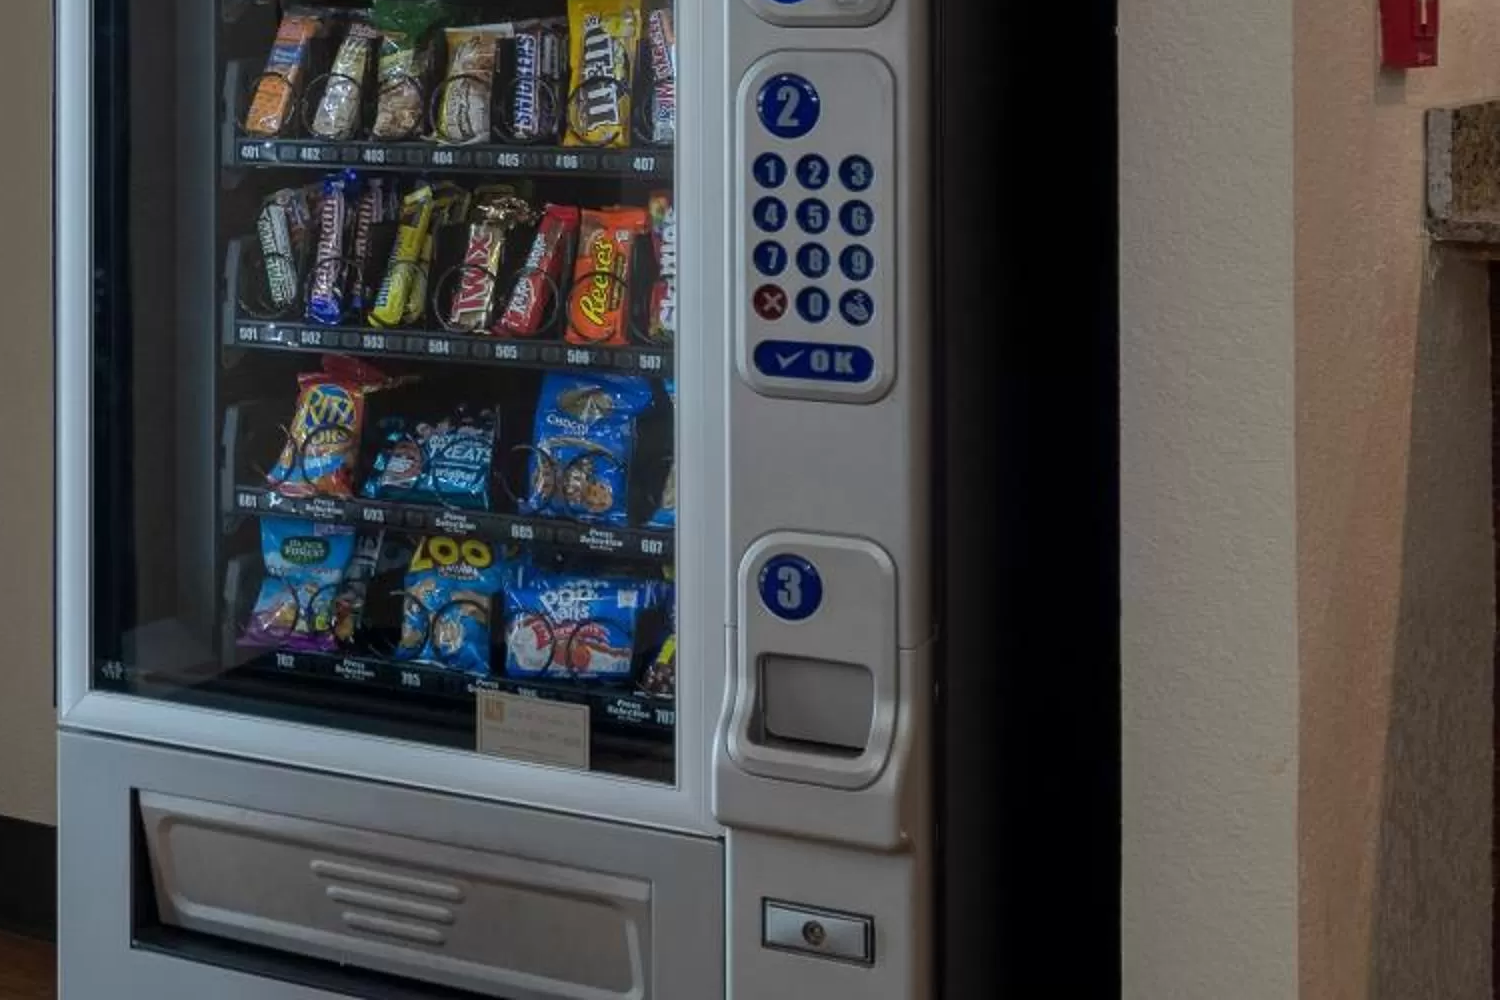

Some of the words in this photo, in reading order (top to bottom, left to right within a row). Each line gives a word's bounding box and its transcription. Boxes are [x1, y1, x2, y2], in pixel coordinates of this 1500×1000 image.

[775, 85, 801, 127] 2
[240, 144, 260, 159] 401
[496, 152, 520, 168] 405
[632, 156, 657, 172] 407
[765, 159, 777, 182] 1
[808, 160, 823, 184] 2
[851, 161, 867, 187] 3
[765, 203, 779, 228] 4
[807, 205, 823, 229] 5
[851, 206, 867, 231] 6
[766, 247, 780, 271] 7
[809, 249, 823, 273] 8
[851, 251, 867, 275] 9
[579, 236, 615, 328] Reese's
[809, 293, 823, 318] 0
[494, 343, 518, 360] 505
[638, 353, 662, 370] 507
[809, 347, 856, 375] OK
[640, 538, 664, 555] 607
[775, 565, 803, 611] 3
